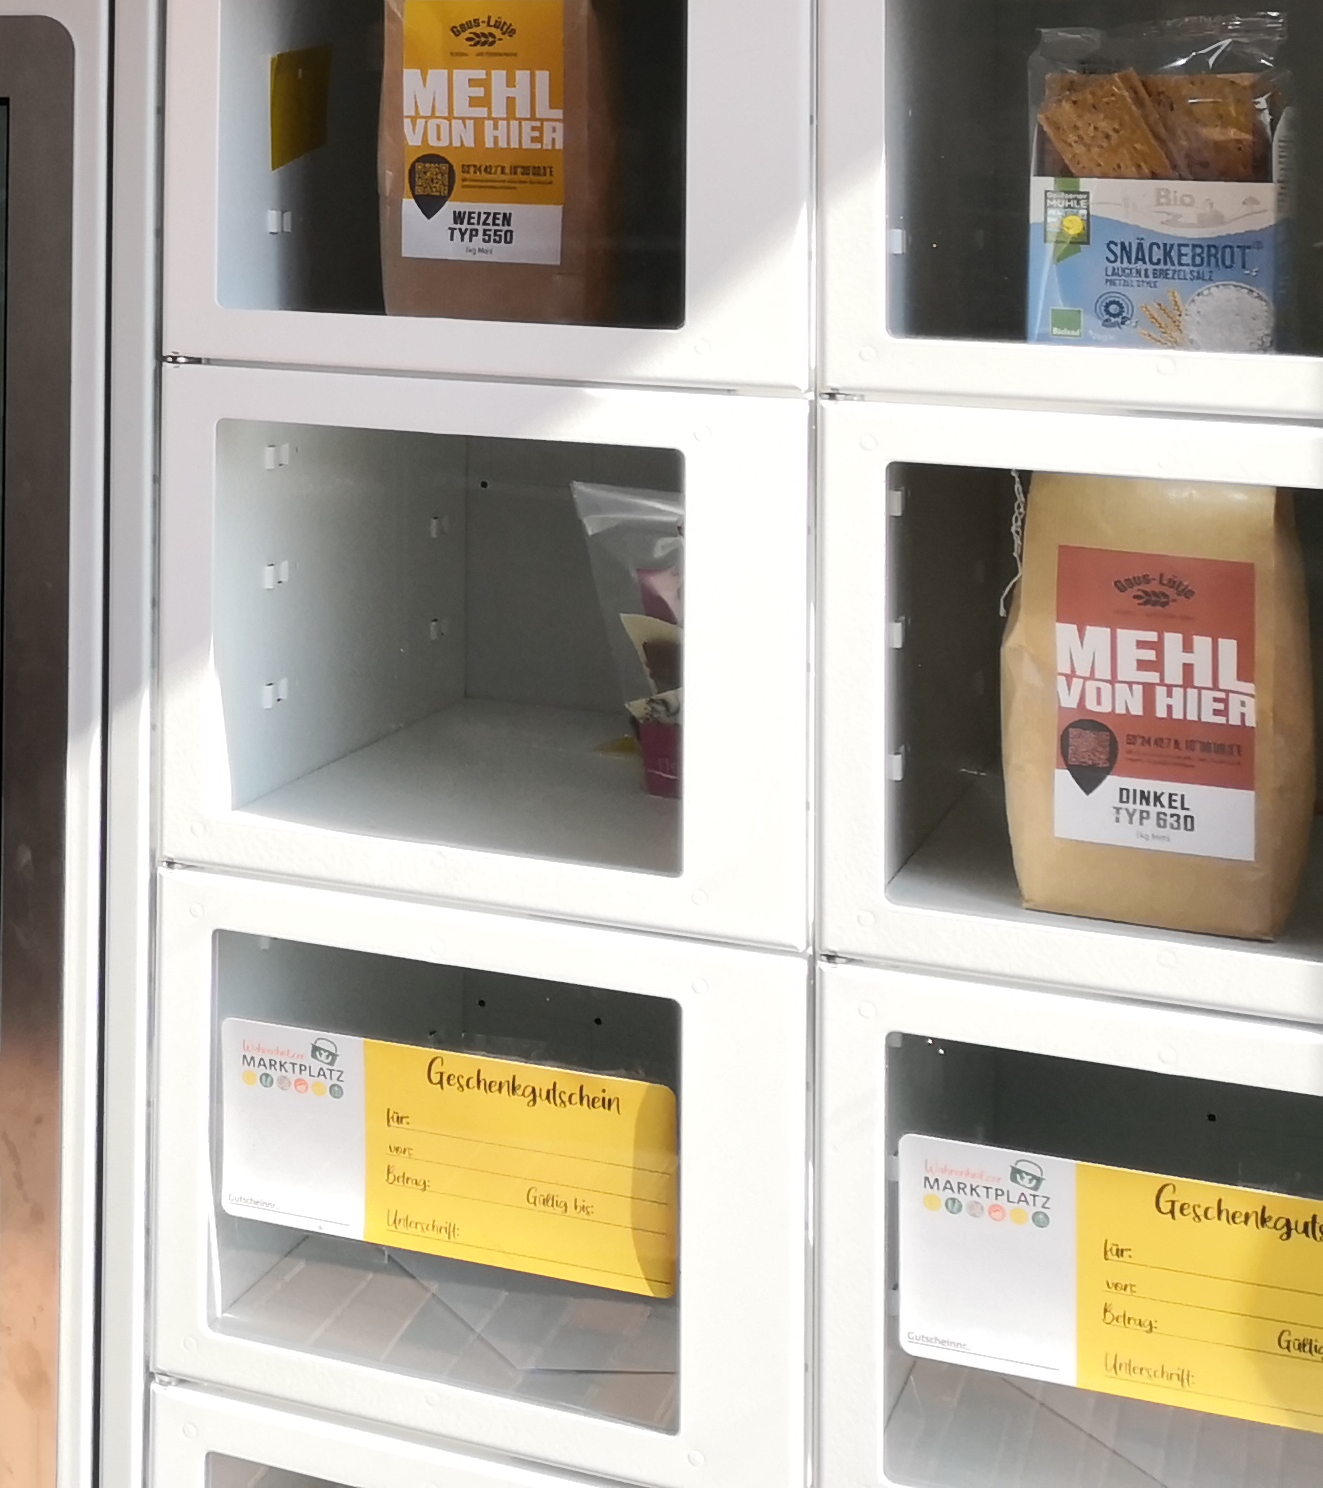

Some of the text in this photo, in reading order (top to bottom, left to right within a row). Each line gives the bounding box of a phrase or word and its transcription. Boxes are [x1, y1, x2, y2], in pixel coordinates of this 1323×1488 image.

[403, 68, 564, 119] MEHL
[403, 118, 564, 150] VON HIER
[1155, 187, 1196, 208] Bio
[452, 210, 513, 227] WEIZEN
[448, 226, 514, 245] TYP 550
[1105, 236, 1253, 270] SNÄCKEBROT
[1055, 621, 1256, 695] MEHL
[1056, 674, 1257, 728] VON HIER
[1118, 787, 1191, 812] DINKEL
[1111, 805, 1196, 833] TYP 630
[241, 1053, 346, 1083] MARKTPLATZ
[426, 1055, 622, 1115] Geschenkgutschein
[384, 1163, 432, 1193] Betrag:
[922, 1175, 1052, 1210] MARKTPLATZ
[525, 1185, 595, 1217] Gültig bis:
[385, 1208, 461, 1241] Unterschrift:
[1101, 1301, 1159, 1335] Betrag:
[1103, 1351, 1197, 1390] Unterschrift:
